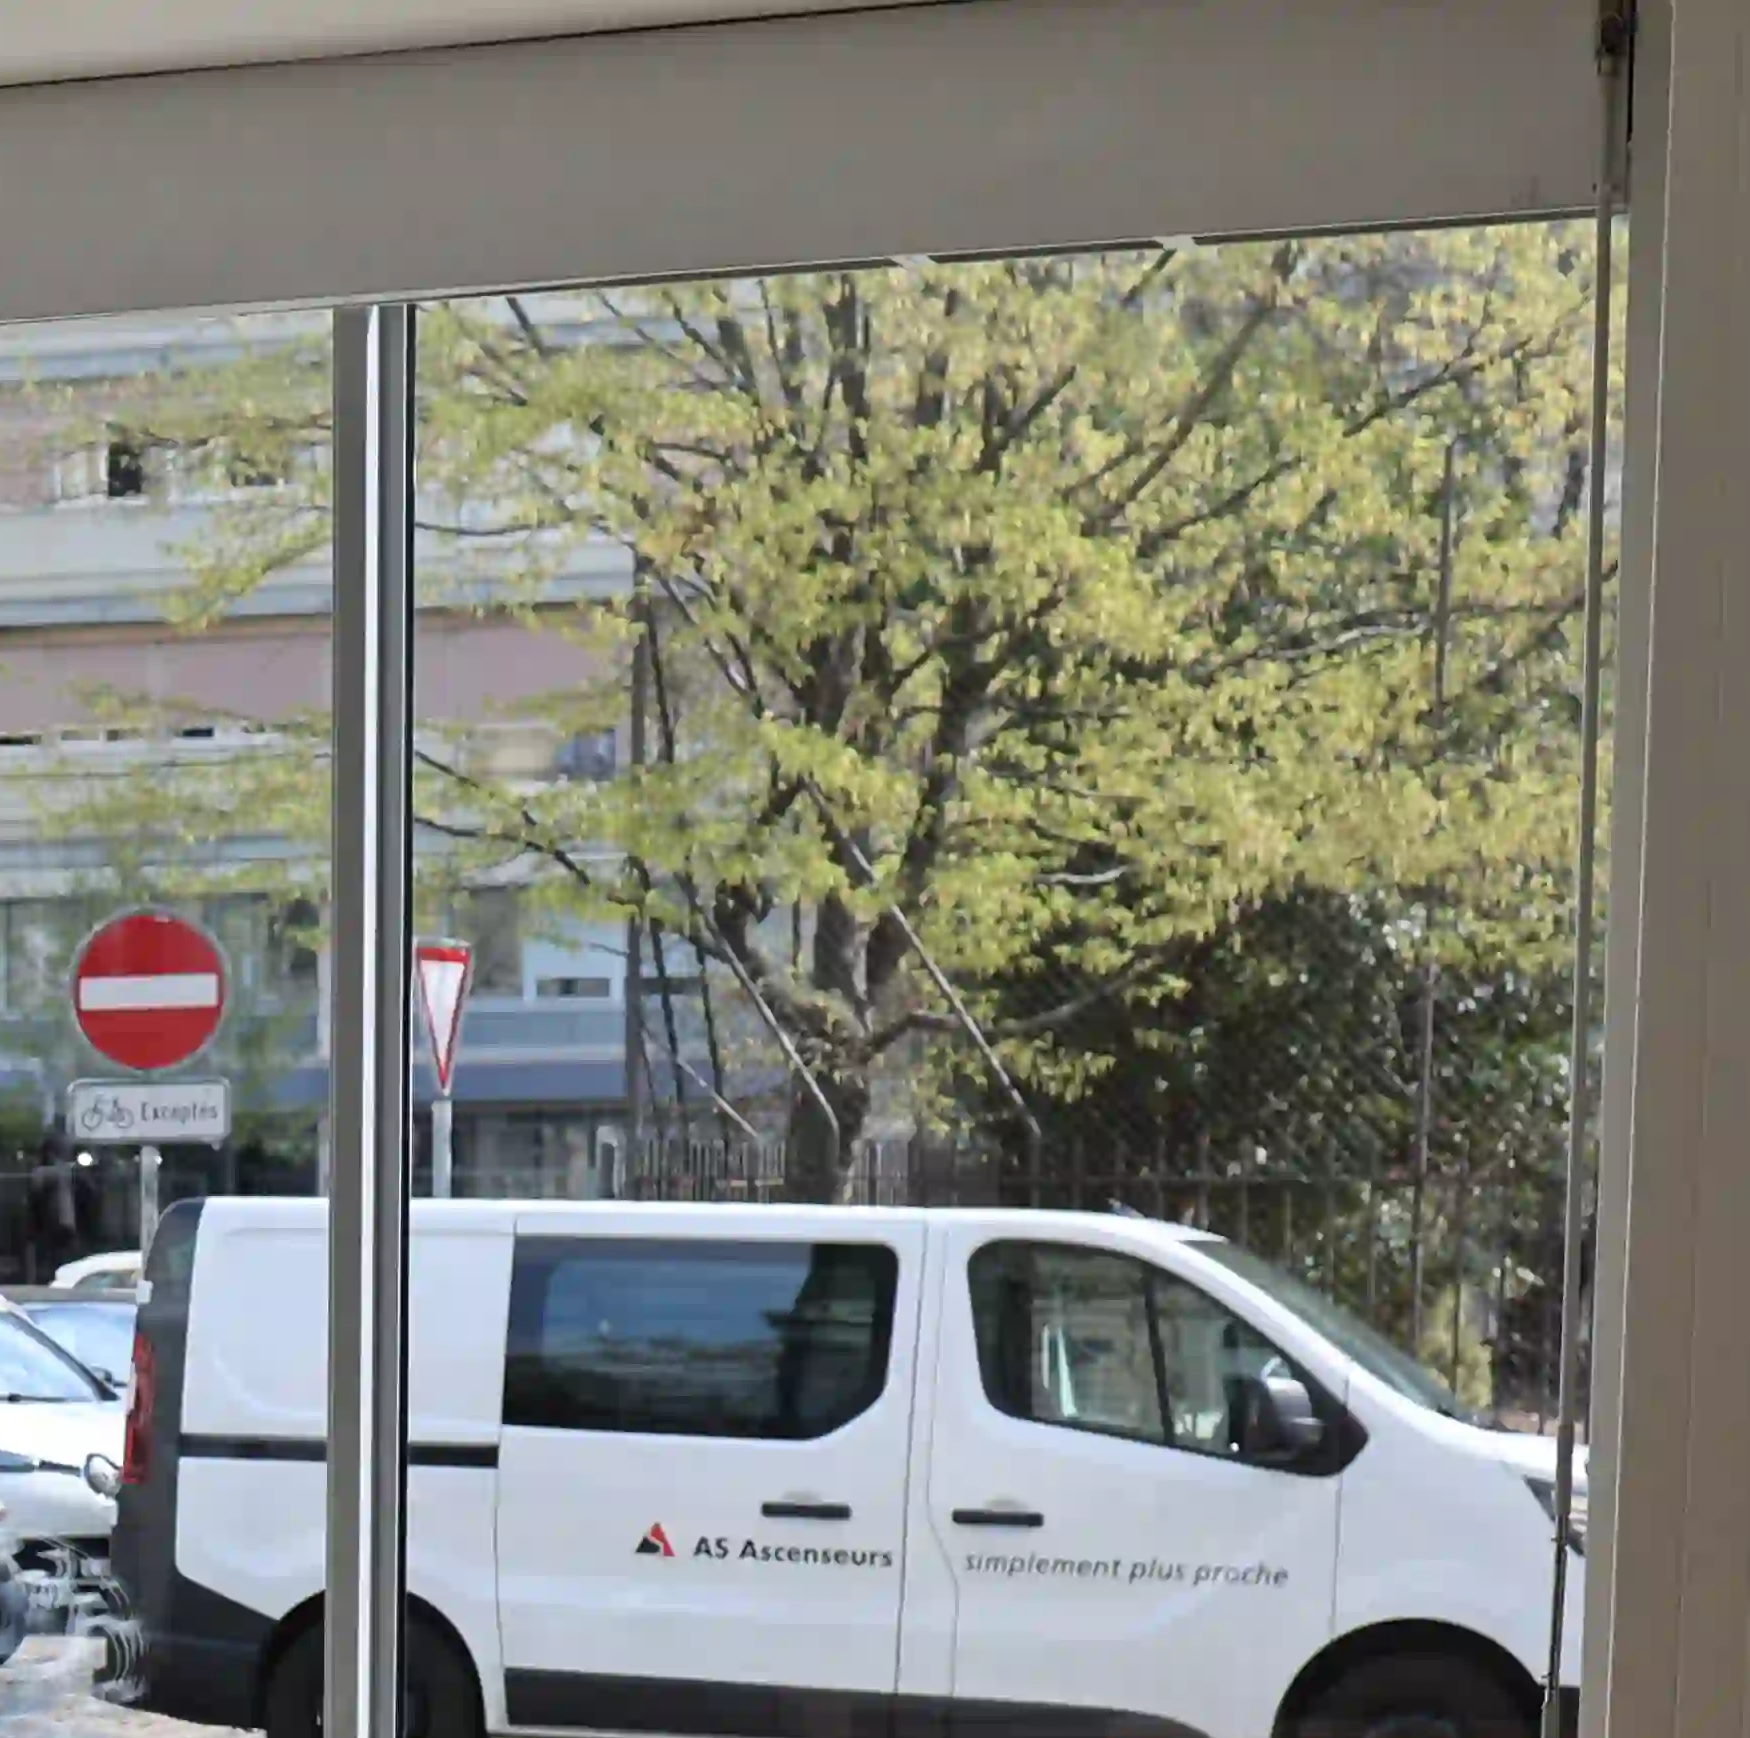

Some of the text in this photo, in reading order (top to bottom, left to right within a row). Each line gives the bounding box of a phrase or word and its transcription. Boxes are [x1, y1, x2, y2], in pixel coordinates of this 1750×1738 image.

[693, 1535, 894, 1568] AS Ascenseurs
[965, 1552, 1290, 1588] simplement plus proche
